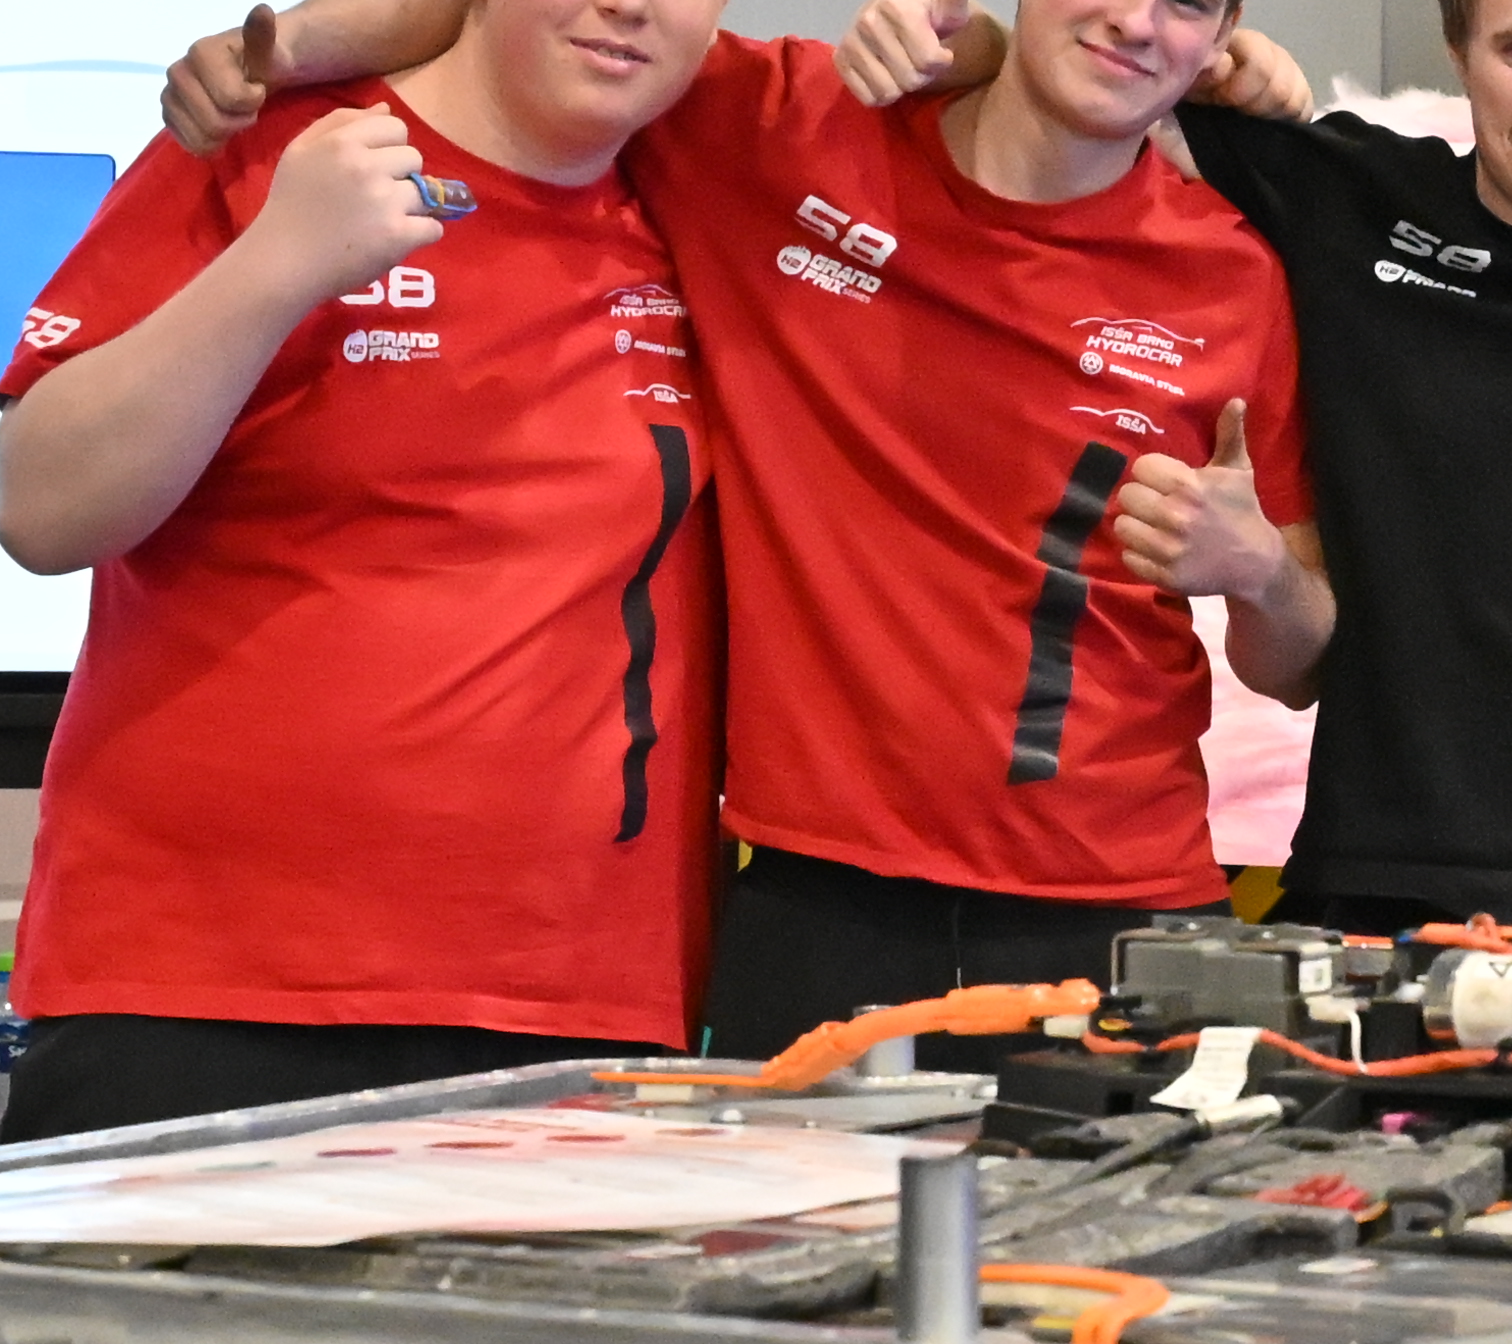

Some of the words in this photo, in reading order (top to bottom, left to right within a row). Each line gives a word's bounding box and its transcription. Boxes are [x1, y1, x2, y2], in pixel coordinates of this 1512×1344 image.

[793, 194, 898, 268] 58
[1388, 219, 1492, 273] 58
[800, 267, 846, 296] PRIX
[809, 254, 882, 294] GRAND
[368, 330, 440, 349] GRAND
[368, 346, 411, 362] PRIX
[1086, 335, 1183, 368] HYDROCAR
[1136, 333, 1175, 351] BRNO
[1109, 363, 1156, 386] MORAVIA
